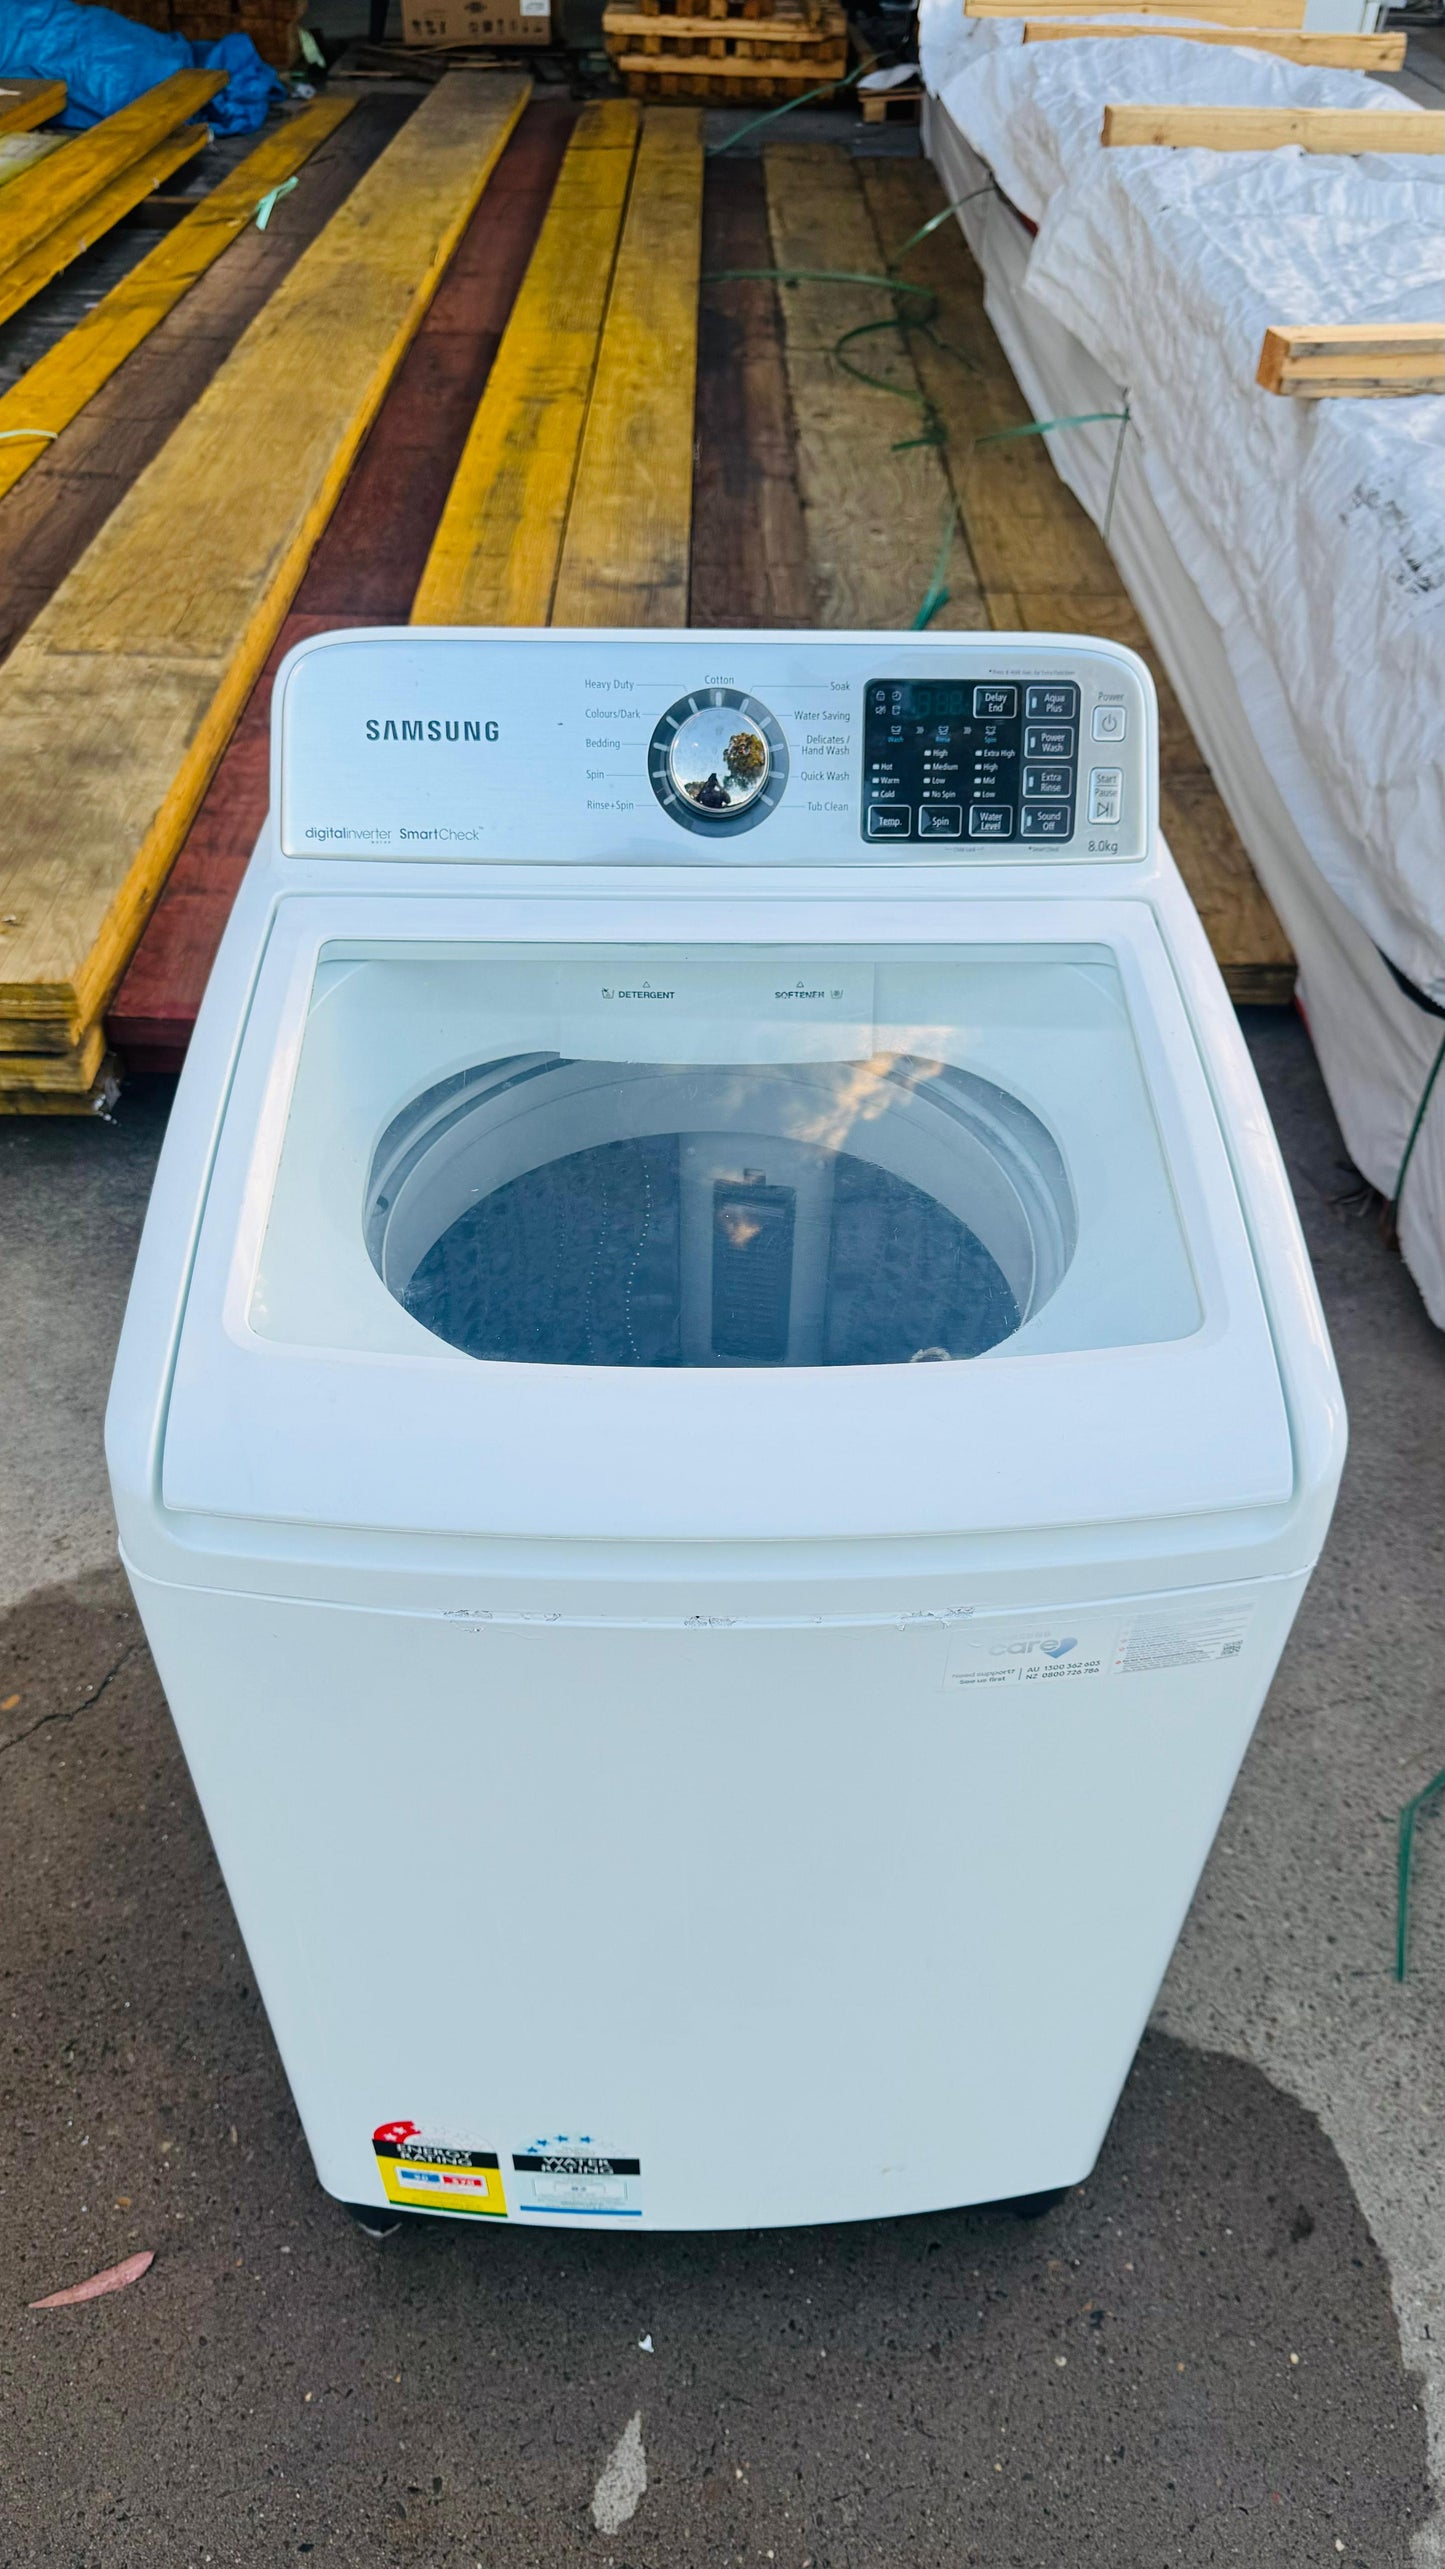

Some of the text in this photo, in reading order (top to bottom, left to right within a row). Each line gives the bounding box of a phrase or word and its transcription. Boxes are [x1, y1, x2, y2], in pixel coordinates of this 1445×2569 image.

[704, 675, 735, 685] Cotton
[585, 680, 635, 692] Heavy Duty
[830, 682, 850, 691] Soak
[985, 693, 1007, 704] Delay
[1045, 694, 1065, 704] Aqua
[1098, 692, 1124, 701] Power
[988, 704, 1003, 712] End
[1046, 704, 1063, 713] Plus
[585, 709, 641, 719] Colours/Dark
[794, 711, 850, 723] Water Saving
[366, 719, 500, 742] SAMSUNG
[806, 735, 844, 745] Delicates
[1041, 734, 1065, 743] Power
[586, 739, 620, 751] Bedding
[1042, 743, 1064, 752] Wash
[802, 746, 850, 756] Hand Wash
[933, 749, 948, 759] High
[984, 749, 1015, 759] Extra High
[881, 763, 893, 771] Hot
[933, 762, 959, 771] Medium
[983, 762, 998, 772] High
[586, 770, 604, 782] Spin
[801, 771, 850, 782] Quick Wash
[881, 777, 900, 785] Warm
[932, 777, 946, 785] Low
[983, 776, 996, 785] Mid
[1041, 773, 1062, 782] Extra
[1096, 774, 1117, 784] Start
[1041, 782, 1062, 792] Rinse
[880, 790, 895, 798] Cold
[931, 790, 956, 799] No Spin
[982, 790, 996, 798] Low
[1094, 788, 1118, 798] Pause
[587, 801, 634, 813] Rinse+Spin
[807, 802, 849, 811] Tub Clean
[980, 812, 1003, 822] Water
[1038, 811, 1061, 821] Sound
[879, 817, 902, 828] Temp.
[932, 816, 950, 828] Spin
[981, 821, 1001, 831] Level
[1043, 821, 1055, 831] Off
[1088, 840, 1118, 854] 8.0kg
[618, 990, 675, 999] DETERGENT
[1041, 1671, 1065, 1679] 0800
[397, 2144, 472, 2159] ENERGY
[400, 2151, 473, 2167] RATING
[542, 2156, 612, 2167] WATER
[541, 2163, 614, 2174] RATING
